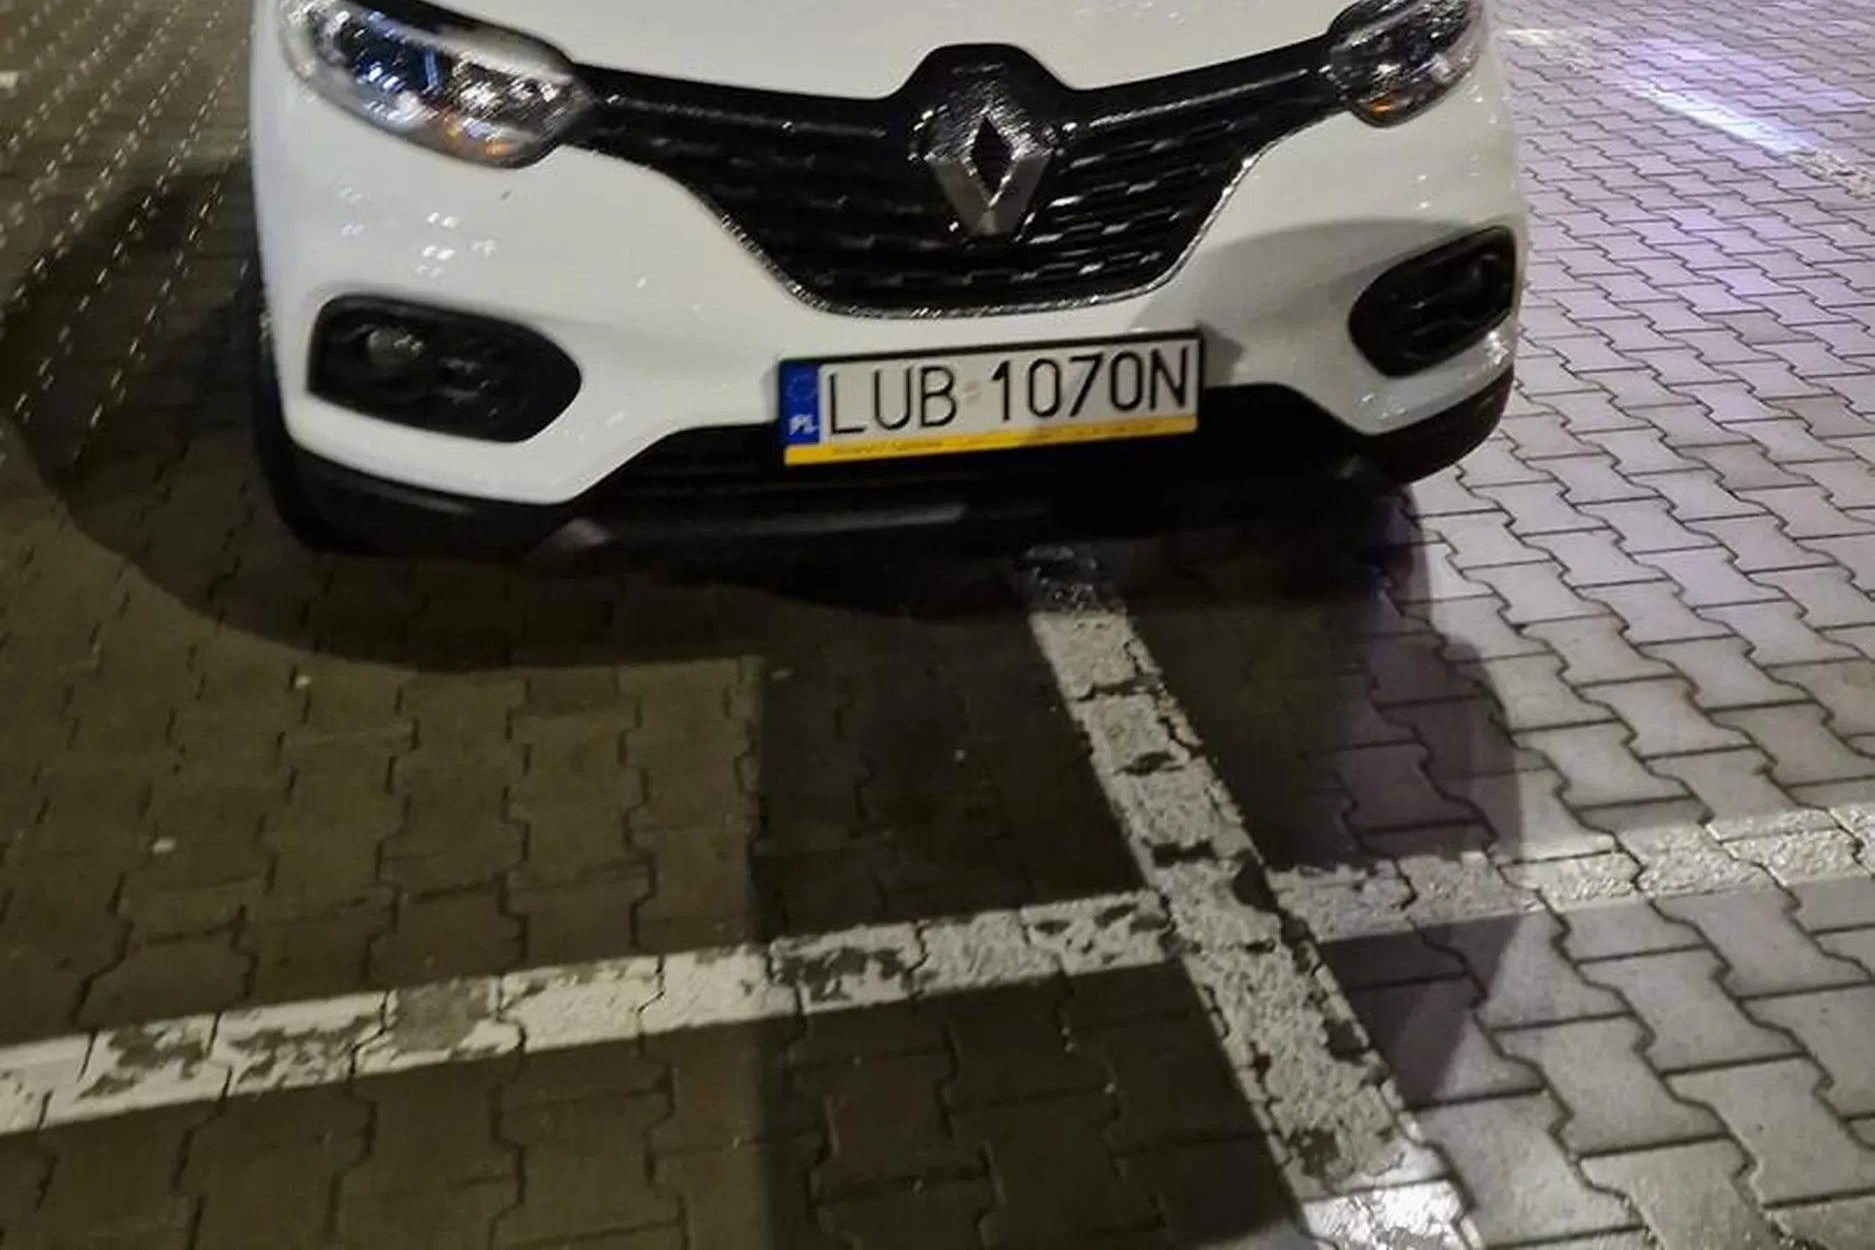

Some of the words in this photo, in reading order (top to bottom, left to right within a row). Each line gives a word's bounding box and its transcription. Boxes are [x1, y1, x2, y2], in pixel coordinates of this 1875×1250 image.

[828, 365, 958, 436] LUB
[990, 346, 1190, 422] 1070N
[788, 414, 818, 436] PL
